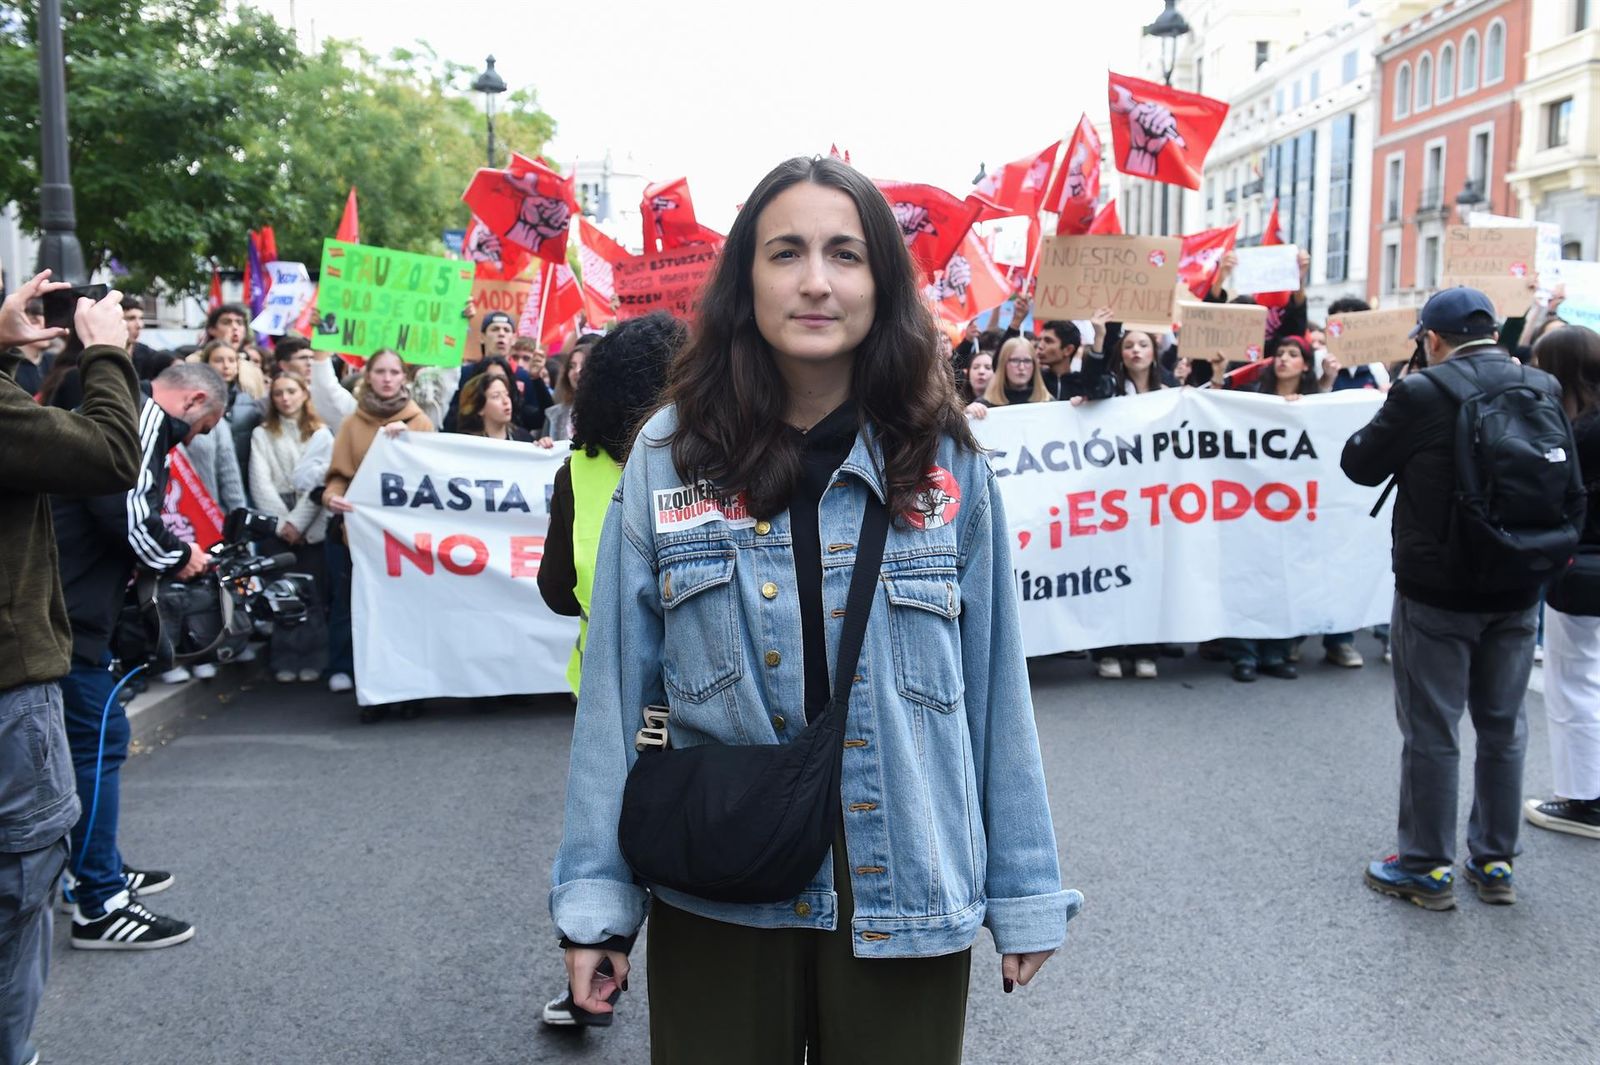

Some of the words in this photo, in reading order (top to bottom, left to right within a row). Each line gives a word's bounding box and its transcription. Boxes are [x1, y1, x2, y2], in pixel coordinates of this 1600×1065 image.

[345, 251, 390, 287] PAU
[391, 258, 452, 296] 2025
[1083, 267, 1149, 286] FUTURO
[326, 284, 372, 313] SOLO
[413, 299, 454, 325] QUE
[473, 289, 529, 315] MODE
[1040, 285, 1069, 308] NO
[1077, 285, 1098, 310] SE
[342, 318, 366, 347] NO
[396, 324, 439, 356] NADA
[987, 428, 1142, 478] CACIÓN
[1153, 421, 1318, 462] PÚBLICA
[380, 472, 531, 513] BASTA
[657, 483, 732, 511] IZQUIERA
[1140, 479, 1319, 526] TODO!
[383, 528, 490, 578] NO
[510, 536, 545, 578] E
[1014, 564, 1132, 601] iantes
